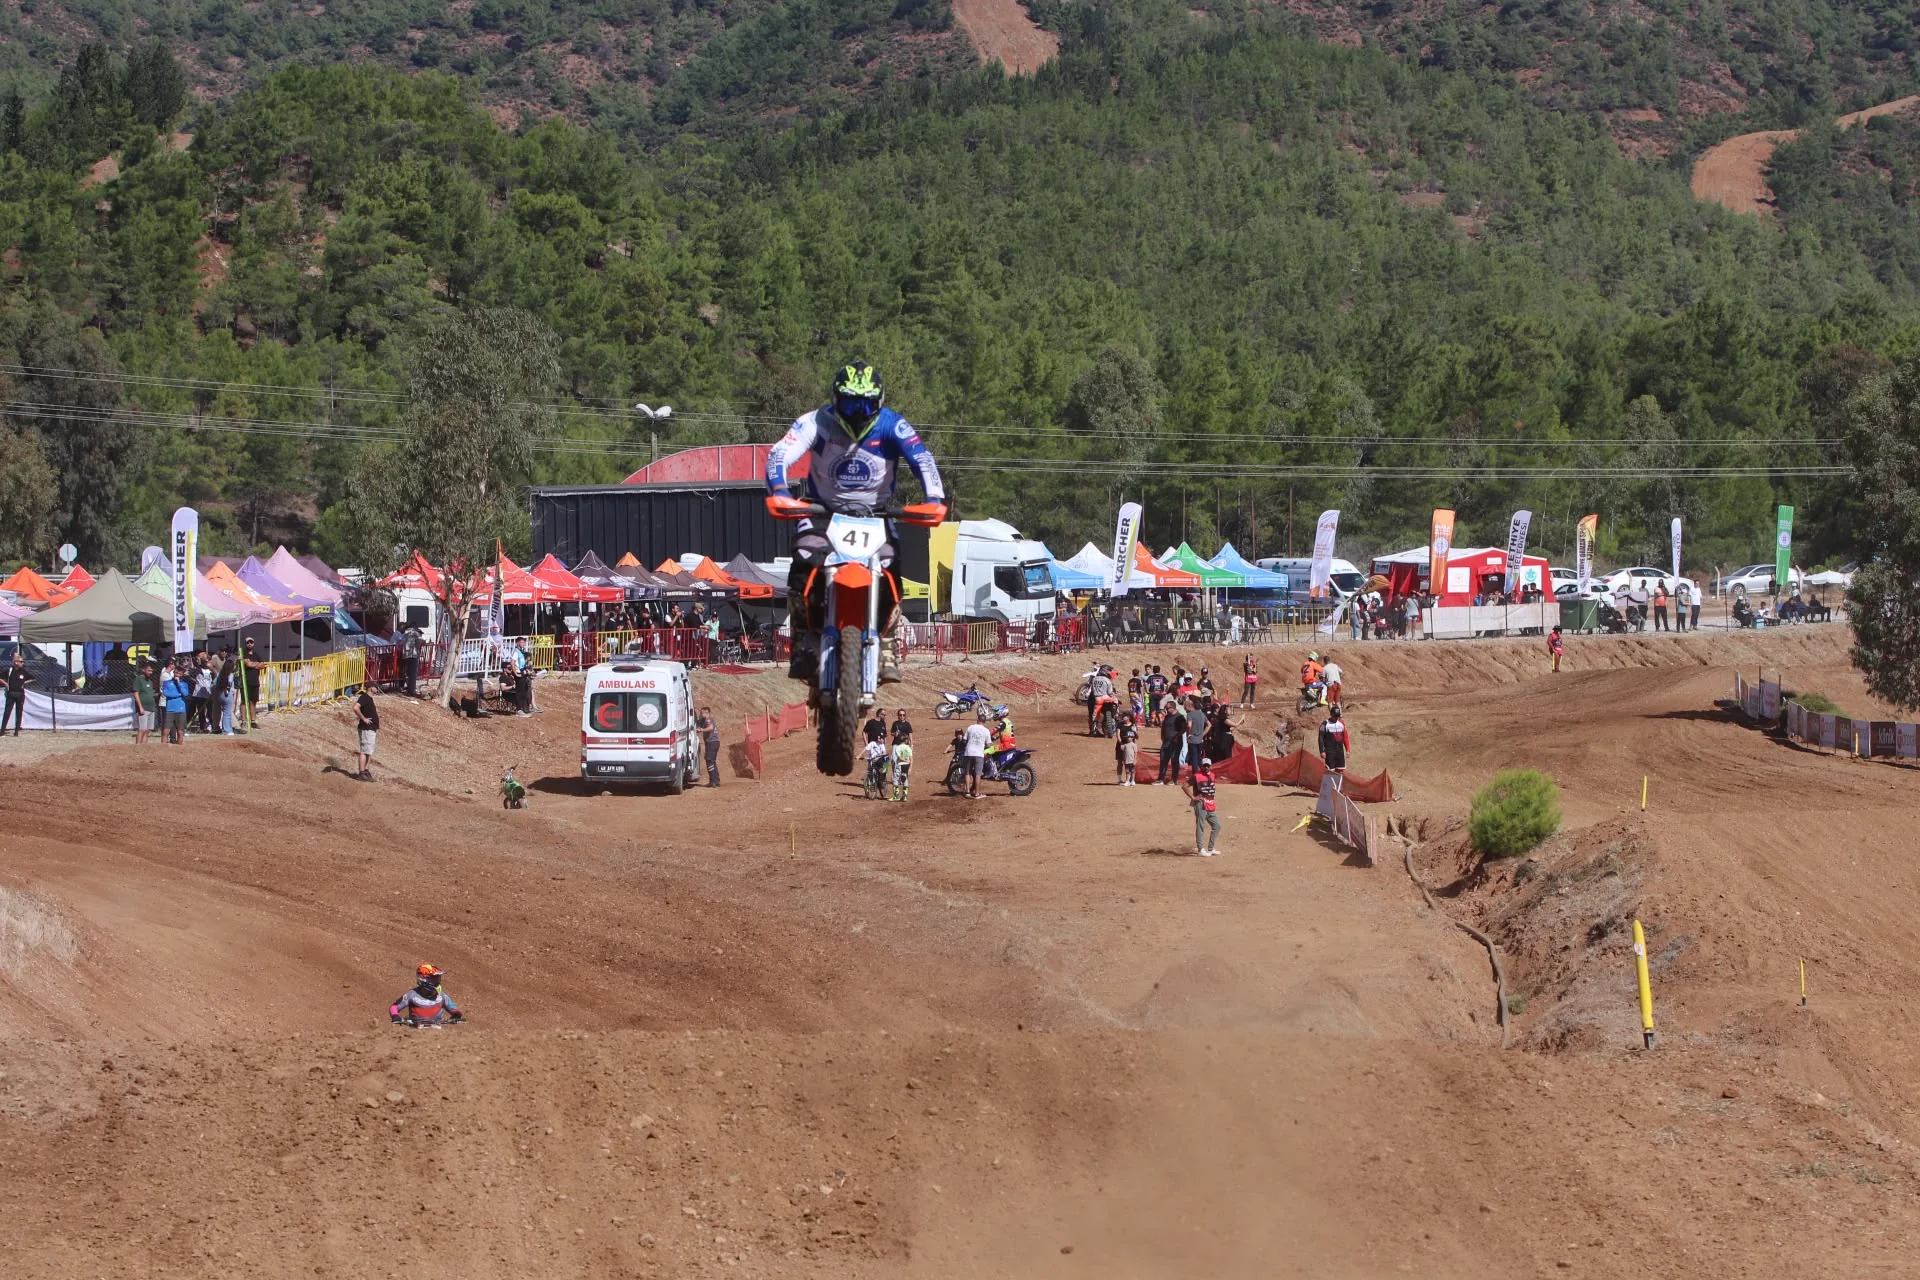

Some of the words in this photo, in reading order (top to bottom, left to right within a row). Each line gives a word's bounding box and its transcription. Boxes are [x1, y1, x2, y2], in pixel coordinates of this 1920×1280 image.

[842, 530, 870, 548] 41
[176, 530, 186, 632] KÄRCHER
[598, 680, 656, 689] AMBULANS
